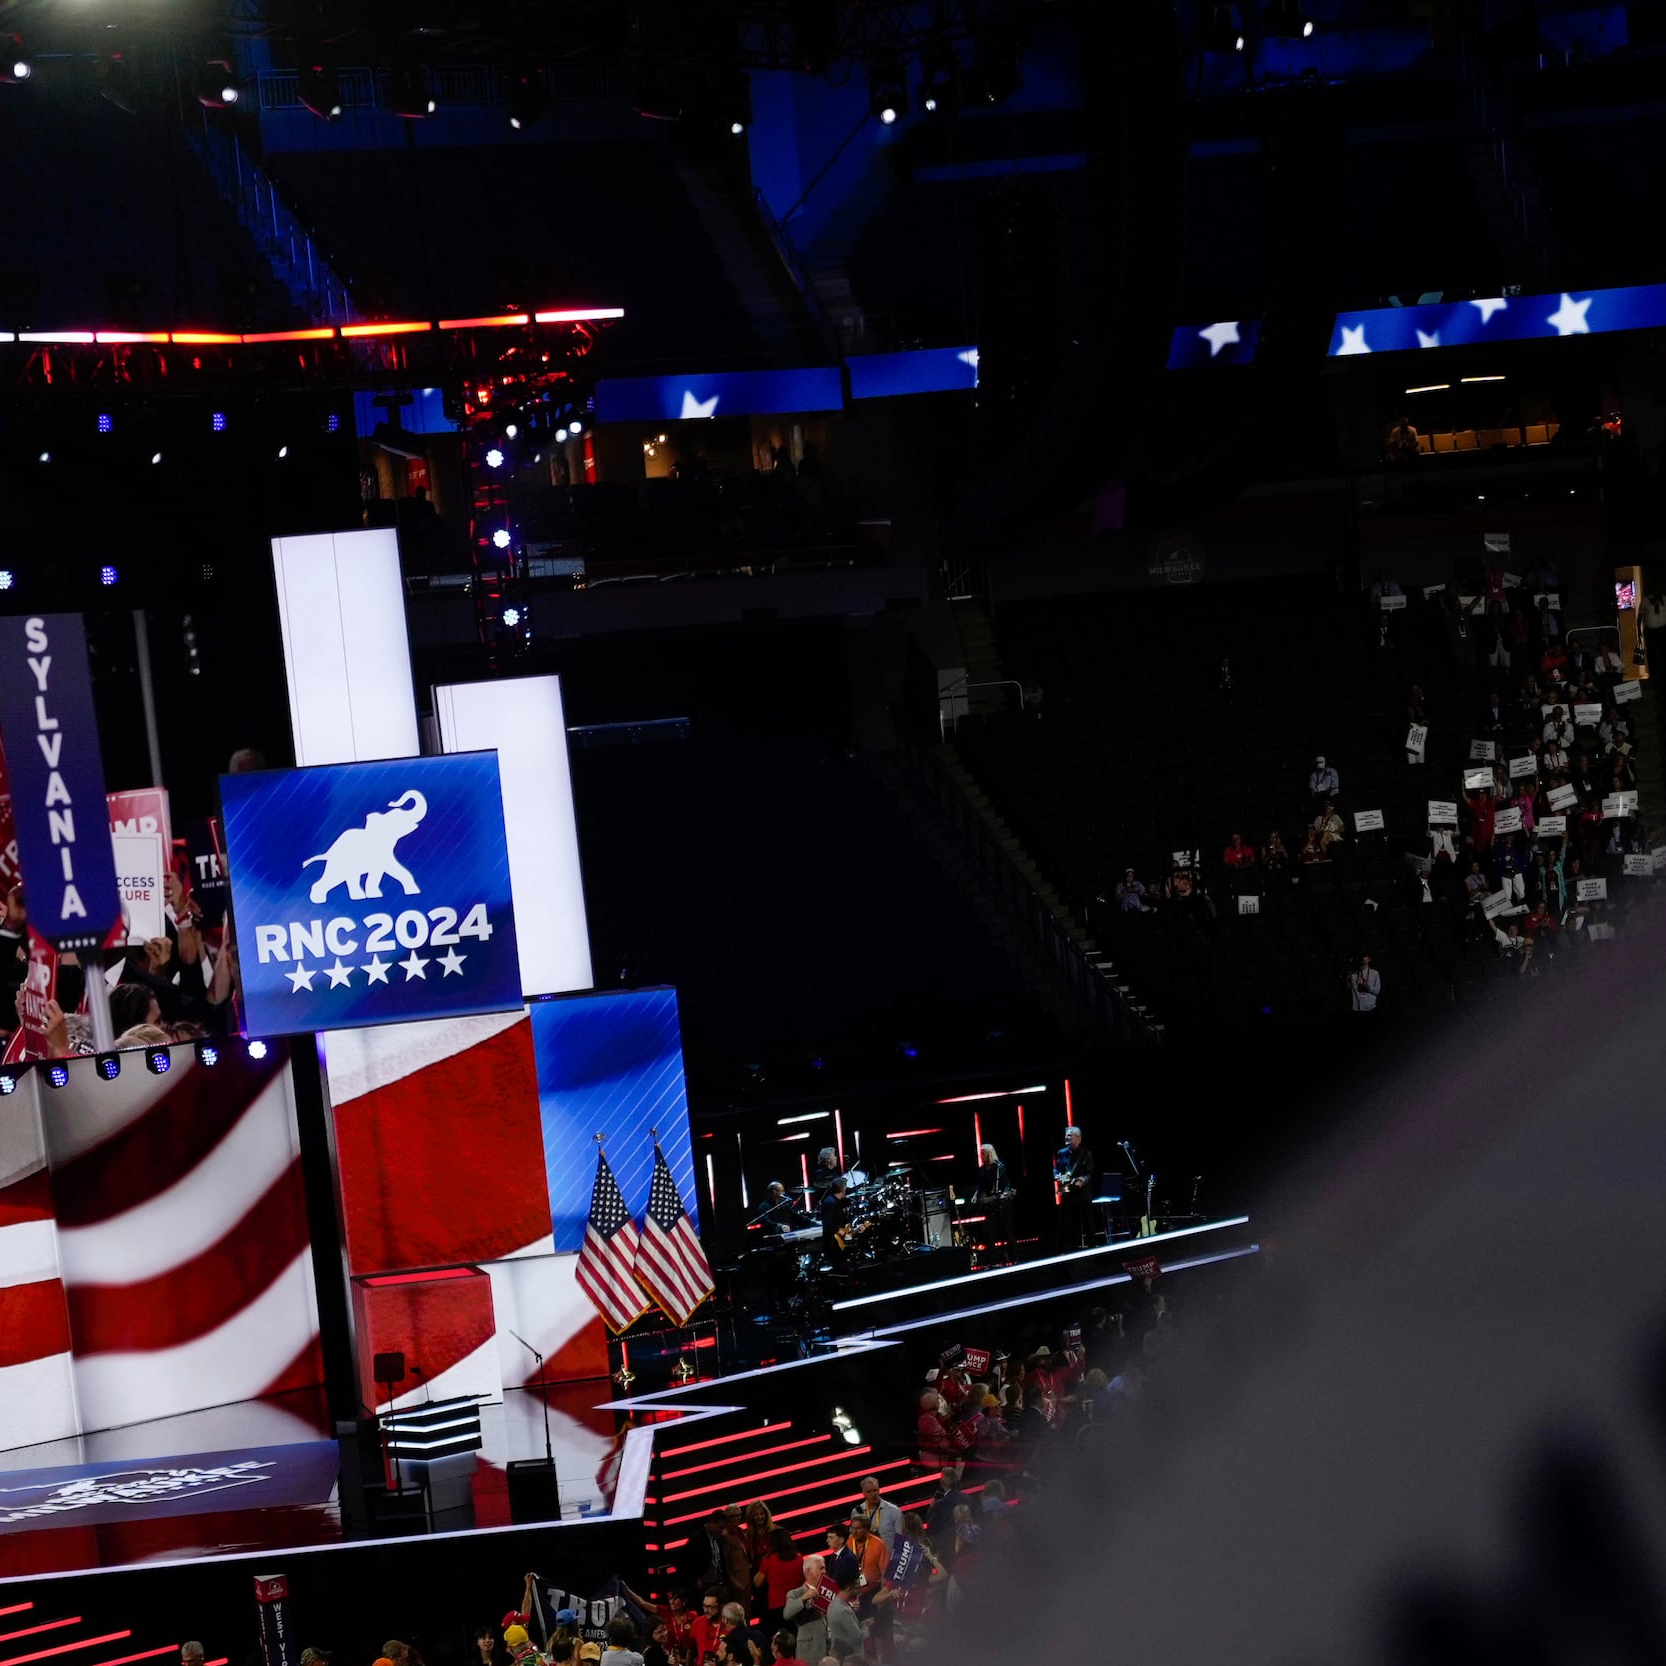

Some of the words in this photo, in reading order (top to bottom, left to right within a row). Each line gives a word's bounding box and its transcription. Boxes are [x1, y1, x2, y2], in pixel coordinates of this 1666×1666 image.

[24, 617, 87, 920] SYLVANIA
[893, 1540, 911, 1580] TRUMP
[272, 1603, 285, 1637] WEST
